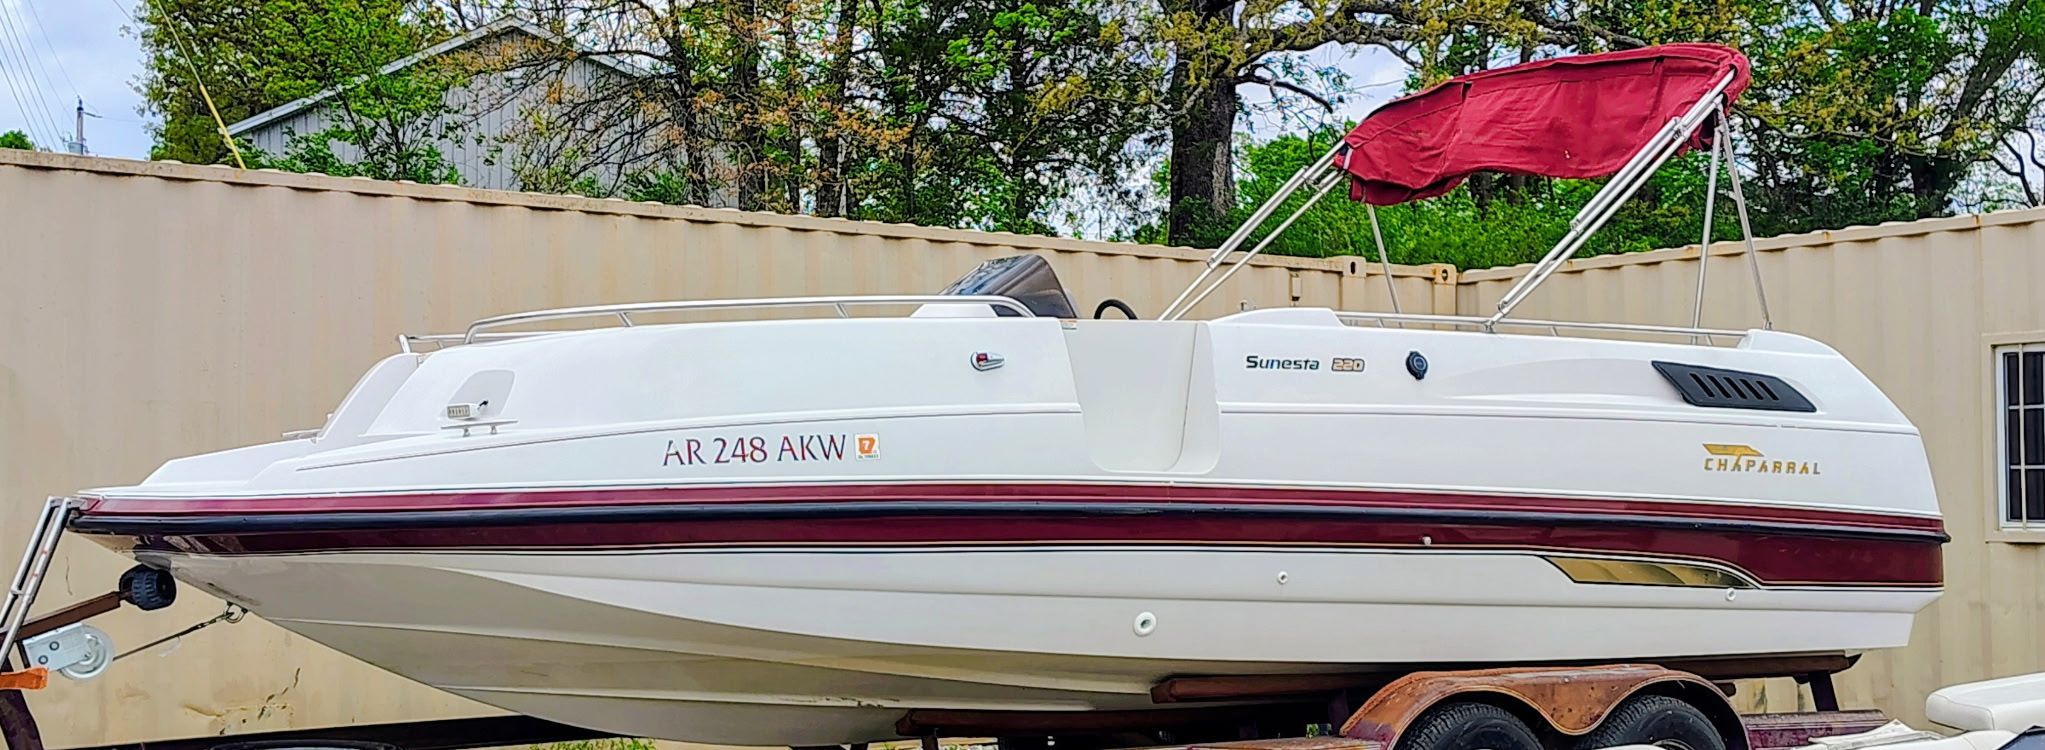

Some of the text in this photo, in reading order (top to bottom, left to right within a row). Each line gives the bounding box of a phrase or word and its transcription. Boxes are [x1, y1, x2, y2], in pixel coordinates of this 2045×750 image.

[1245, 355, 1366, 373] Sunesta 220
[662, 434, 847, 466] AR 248 AKW
[1703, 458, 1821, 475] CHAPARRAL
